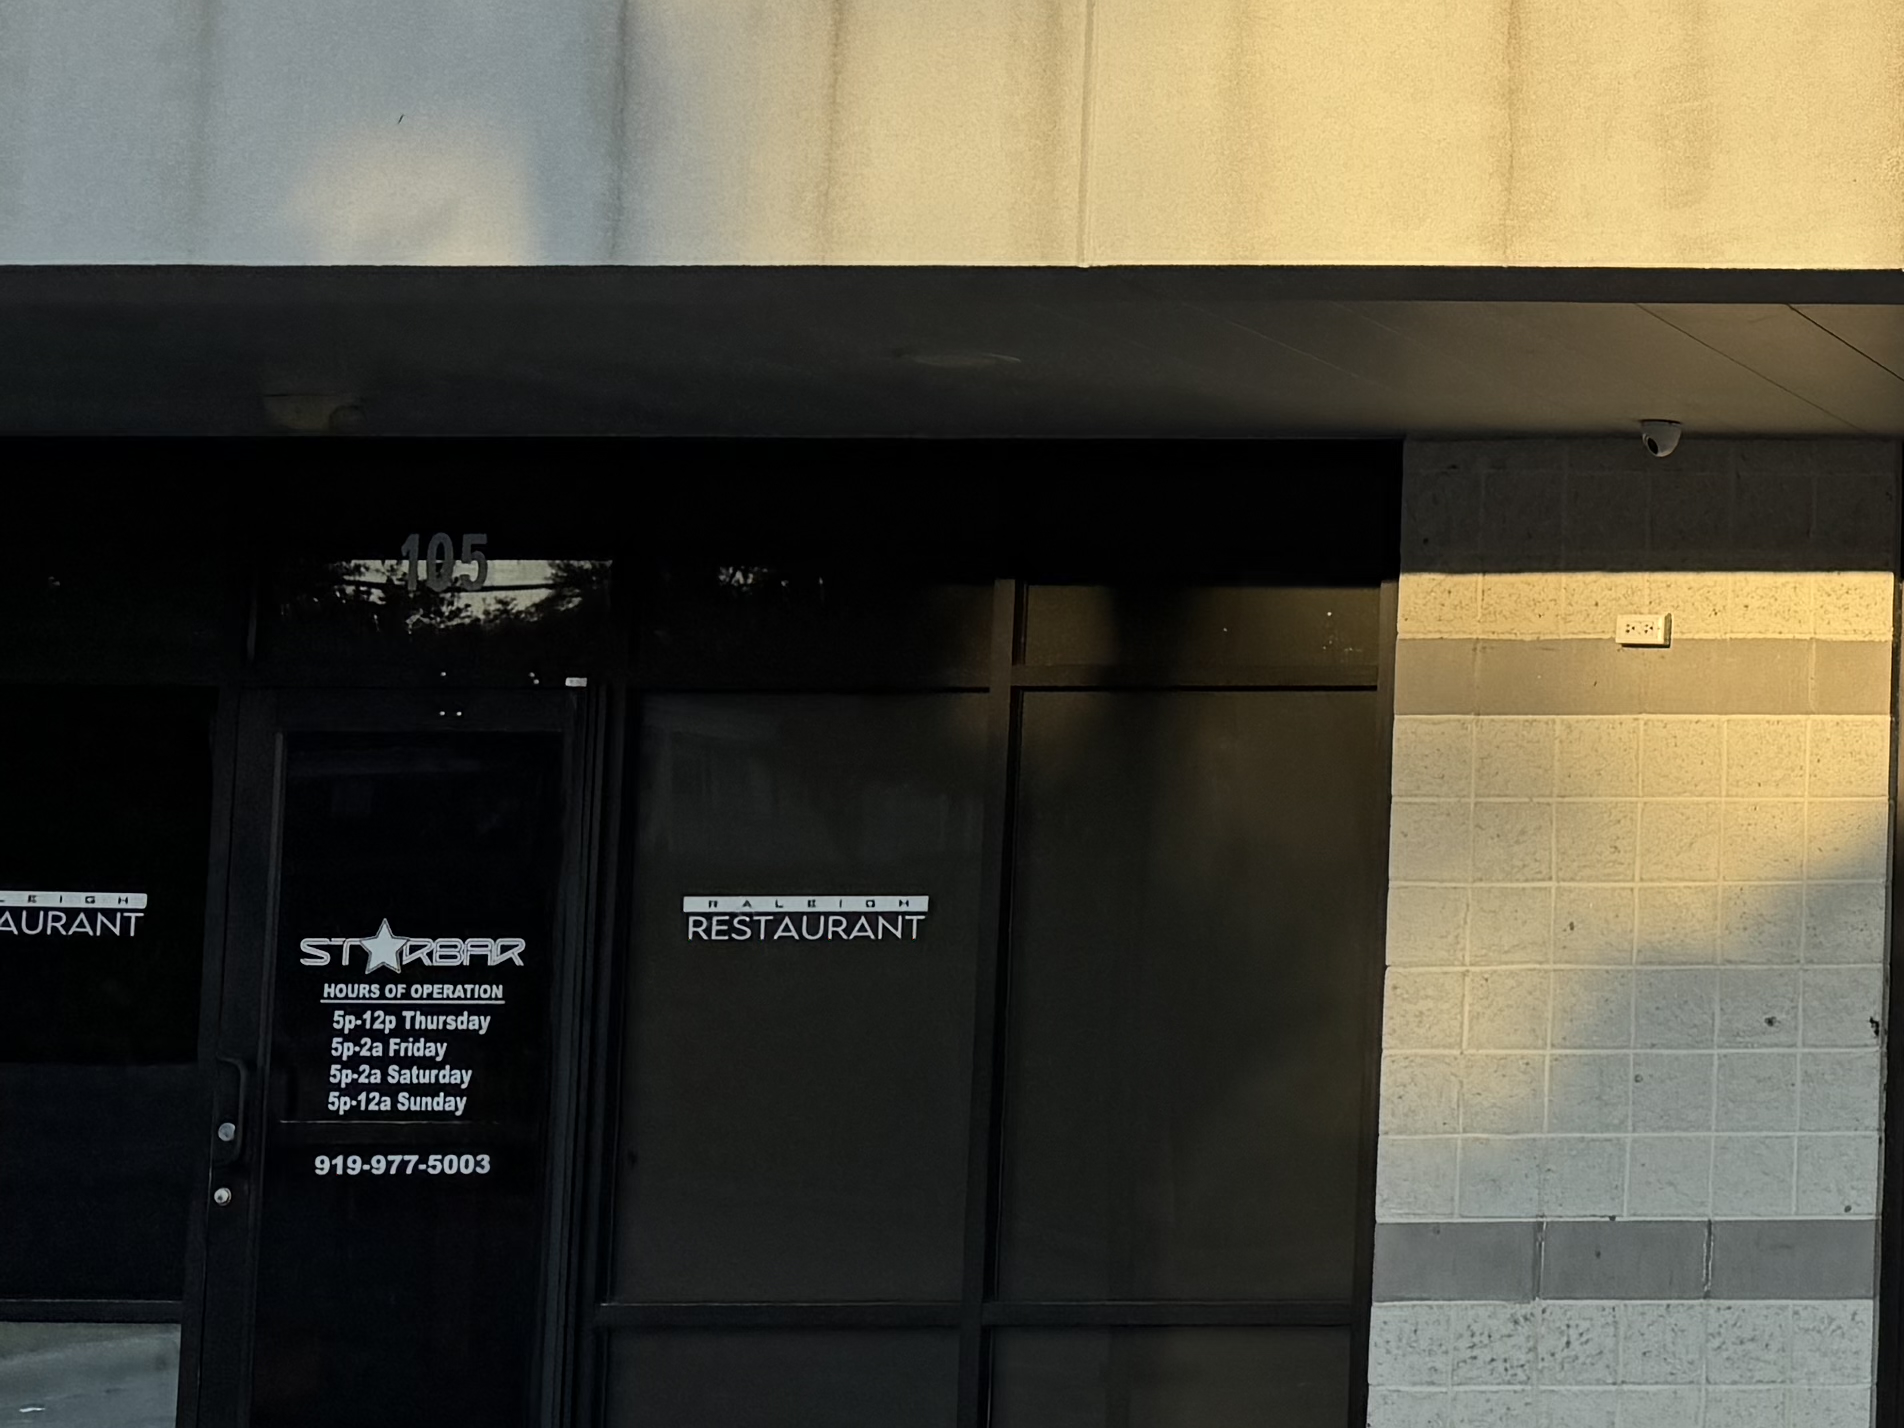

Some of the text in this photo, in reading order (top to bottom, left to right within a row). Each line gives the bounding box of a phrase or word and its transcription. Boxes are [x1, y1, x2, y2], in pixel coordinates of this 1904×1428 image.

[399, 532, 490, 593] 105
[708, 898, 910, 909] RALEIGH
[687, 915, 926, 941] RESTAURANT
[323, 983, 504, 999] HOURS OF OPERATION
[332, 1010, 491, 1035] 5p-12p Thursday
[330, 1037, 448, 1062] 5p-2a Friday
[329, 1064, 473, 1089] 5p-2a Saturday
[327, 1091, 467, 1116] 5p-12a Sunday
[314, 1154, 491, 1176] 919-977-5003
